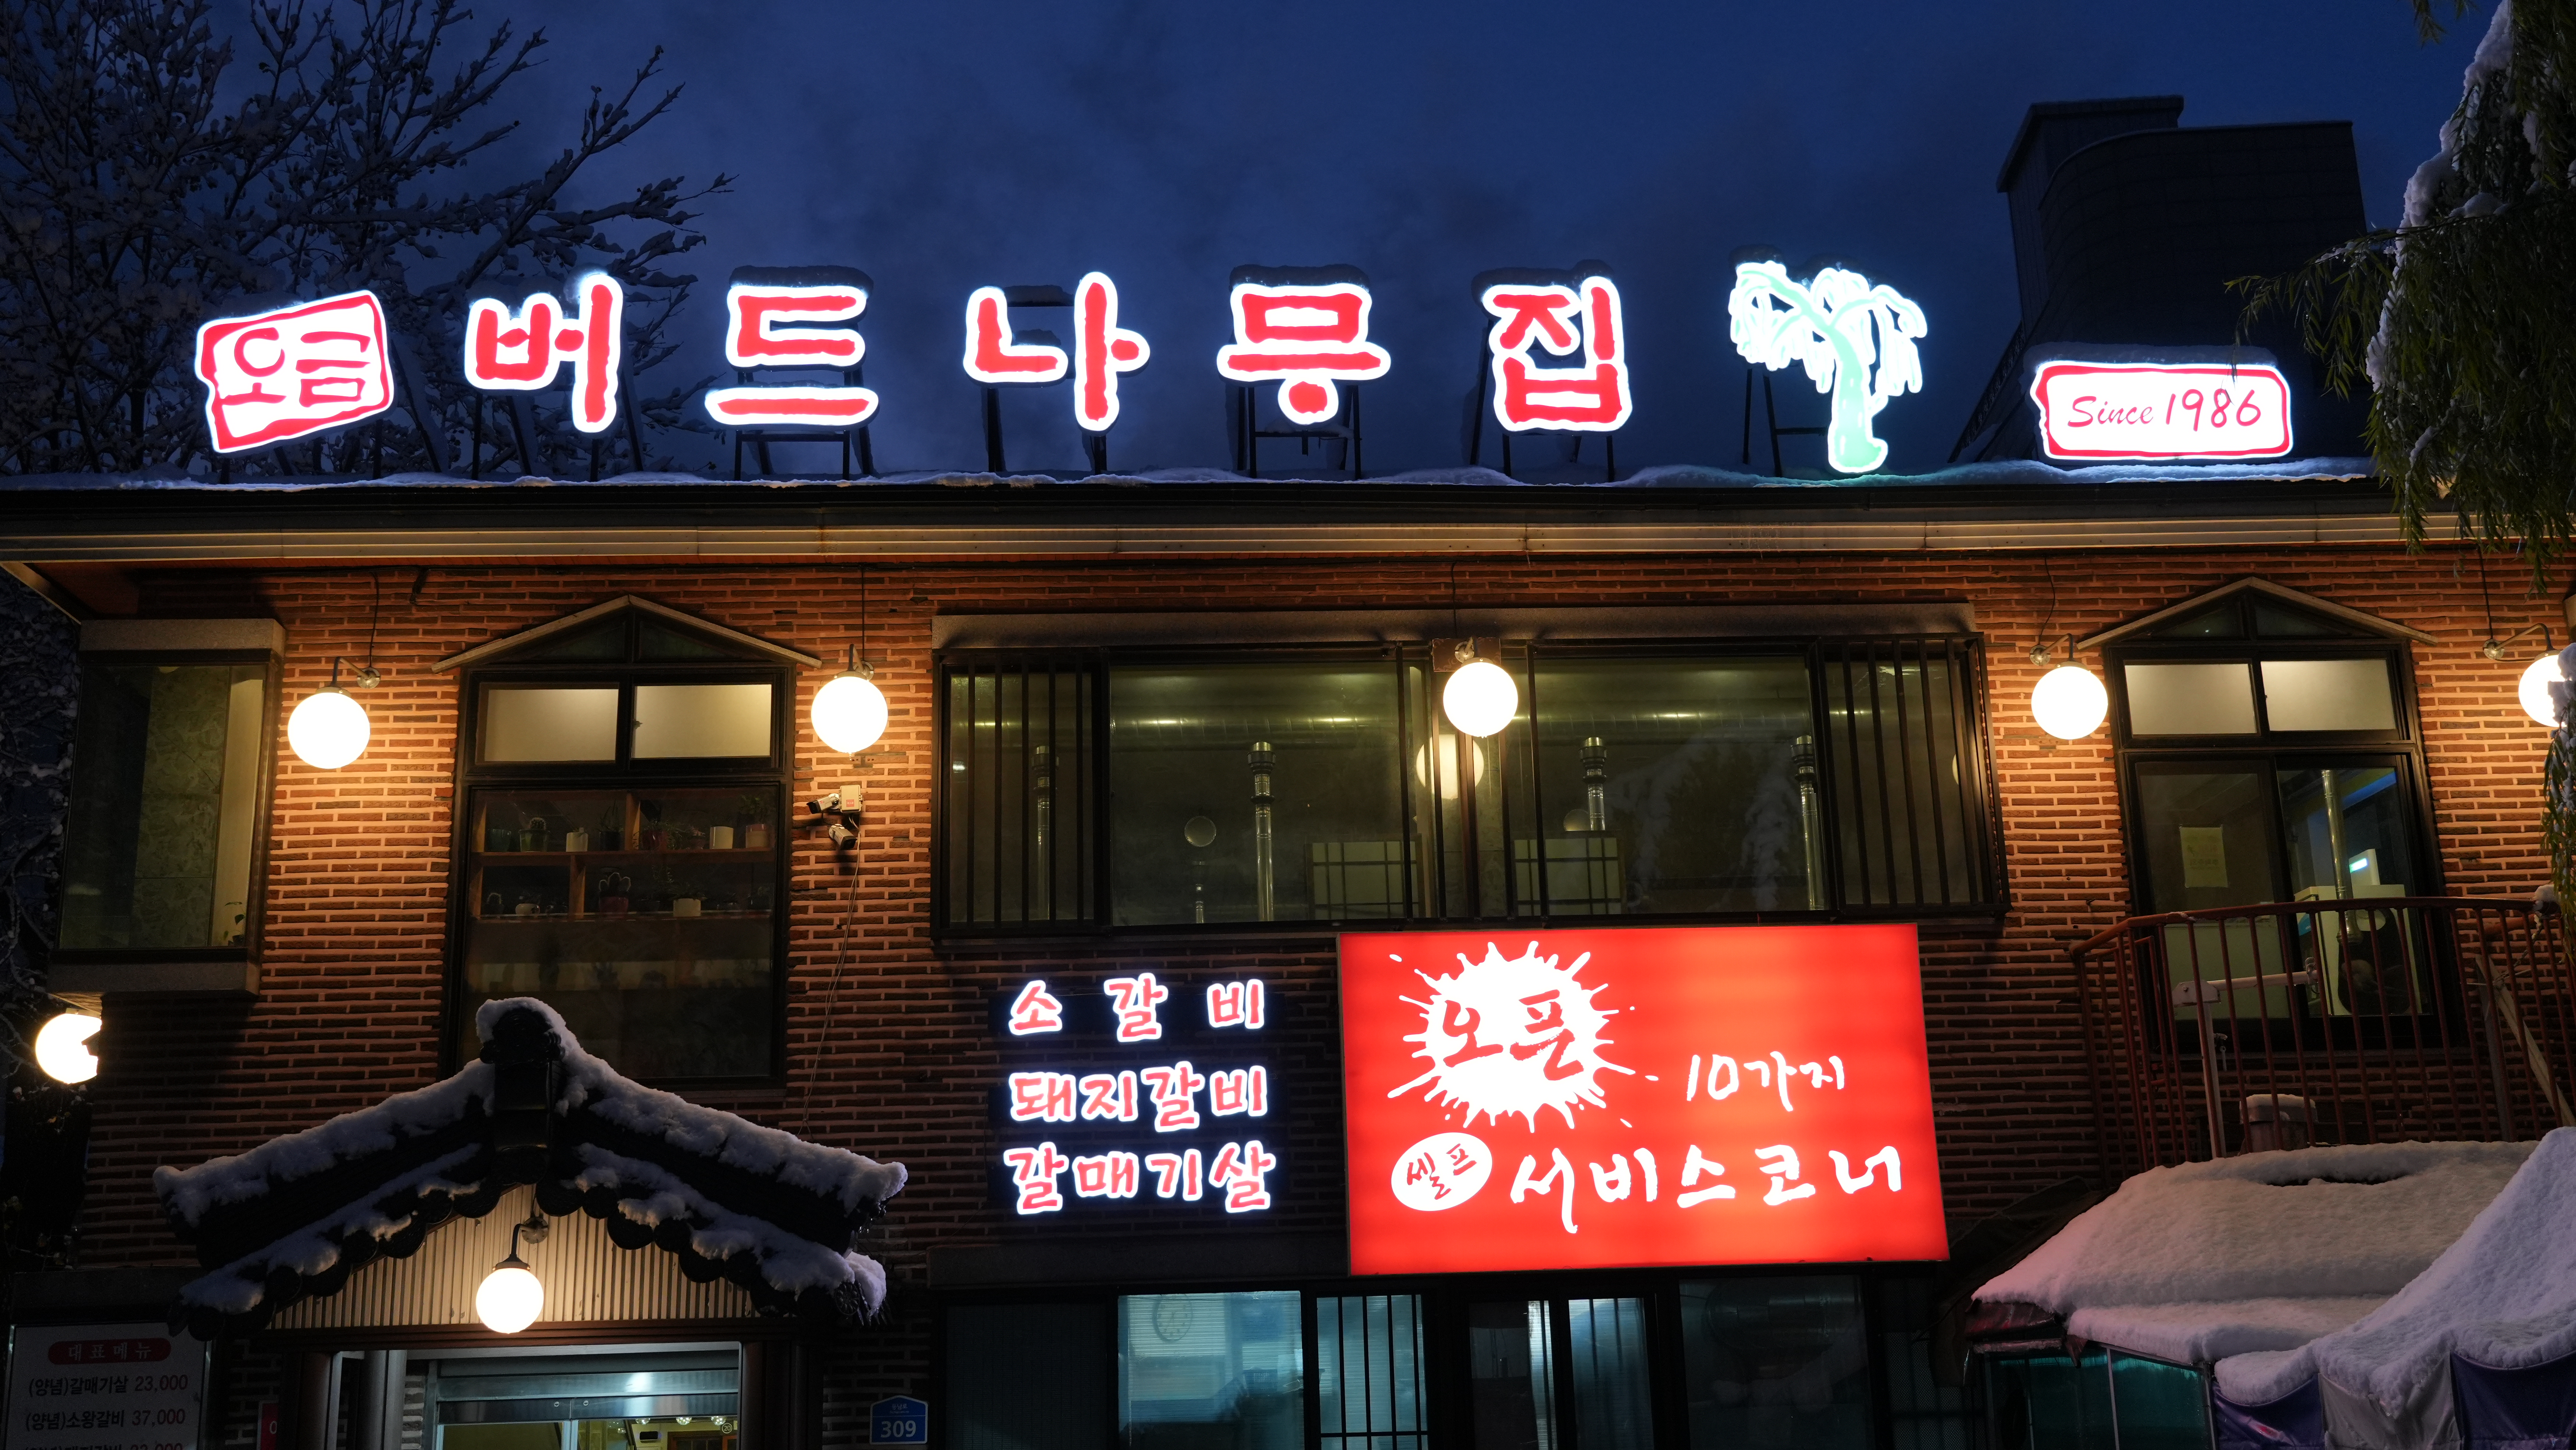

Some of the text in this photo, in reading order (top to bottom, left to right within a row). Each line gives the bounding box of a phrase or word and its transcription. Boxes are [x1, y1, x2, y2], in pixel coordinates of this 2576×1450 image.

[221, 326, 371, 408] 오금
[471, 278, 1627, 428] 버드나무집
[2068, 389, 2261, 432] Since 1986
[1012, 976, 1261, 1040] 소갈비
[1442, 989, 1584, 1081] 오픈
[1012, 1064, 1264, 1129] 돼지갈비
[1686, 1051, 1845, 1112] 10가지
[1006, 1143, 1273, 1212] 갈매기살
[1407, 1143, 1477, 1200] 셀프
[68, 1342, 152, 1361] 대표메뉴
[29, 1374, 188, 1397] (양념)갈매기살 23,000
[132, 1408, 186, 1427] 37,000
[880, 1420, 916, 1438] 309
